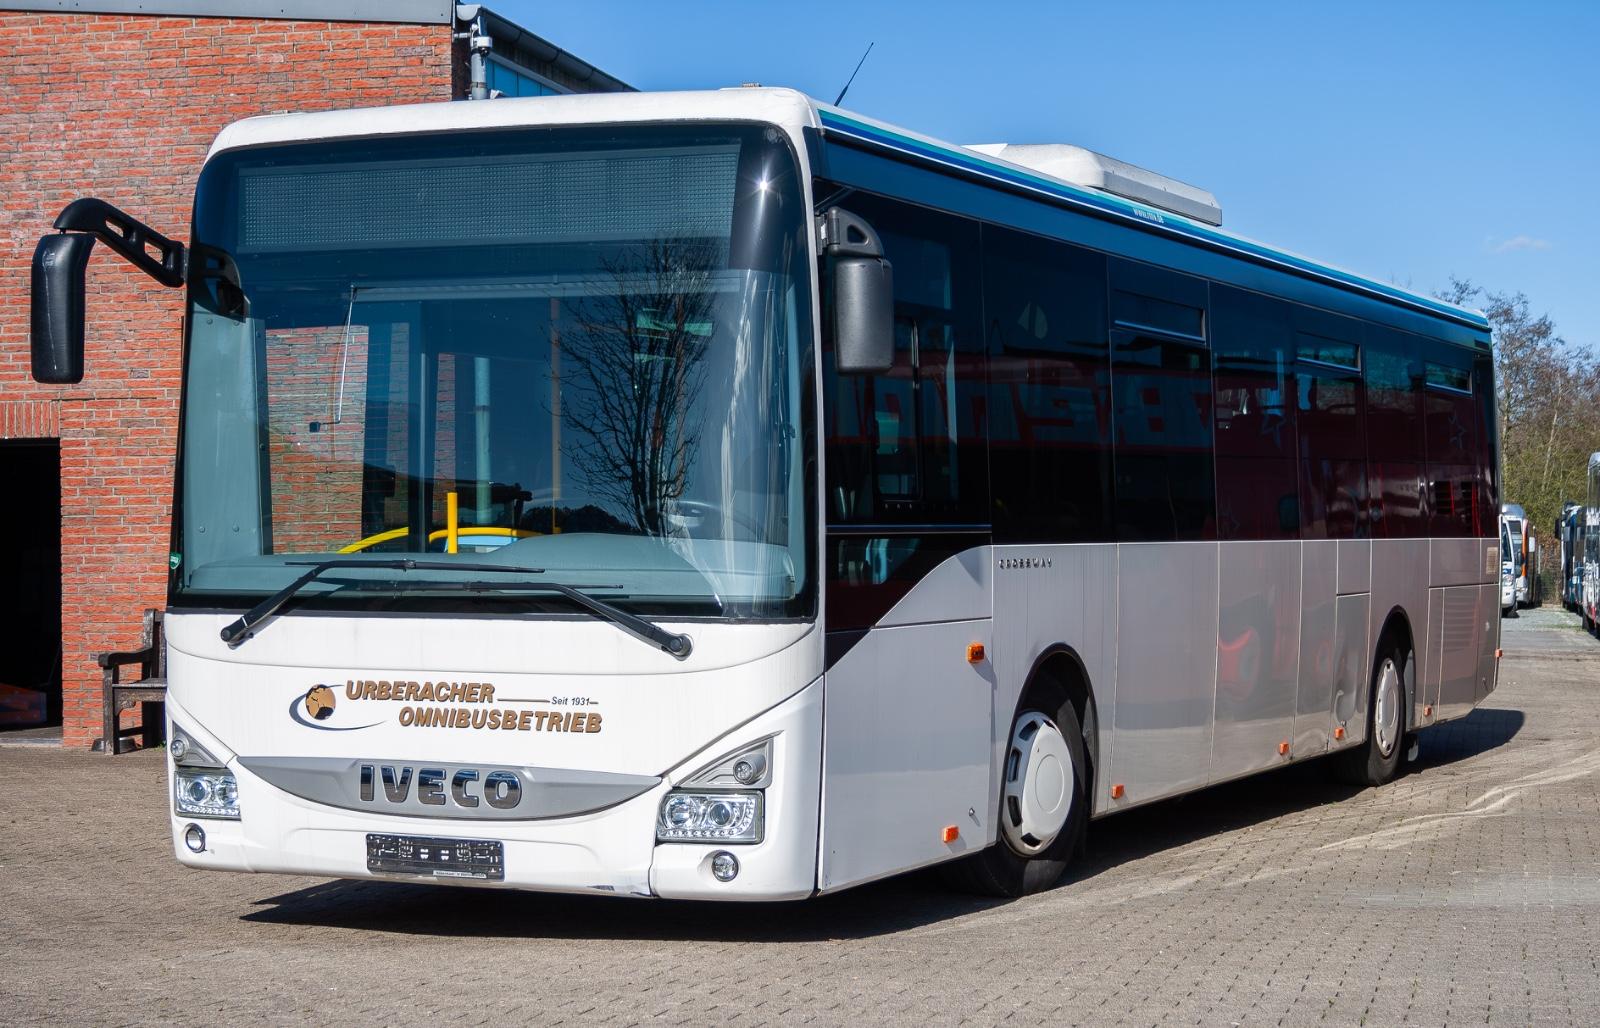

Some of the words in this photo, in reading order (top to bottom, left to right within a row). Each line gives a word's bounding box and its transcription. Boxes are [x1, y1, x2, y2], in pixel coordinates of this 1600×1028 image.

[345, 680, 496, 704] URBERACHER
[551, 696, 569, 706] Seit
[571, 696, 590, 706] 1931
[398, 706, 603, 734] OMNIBUSBETRIEB
[359, 764, 523, 810] IVECO
